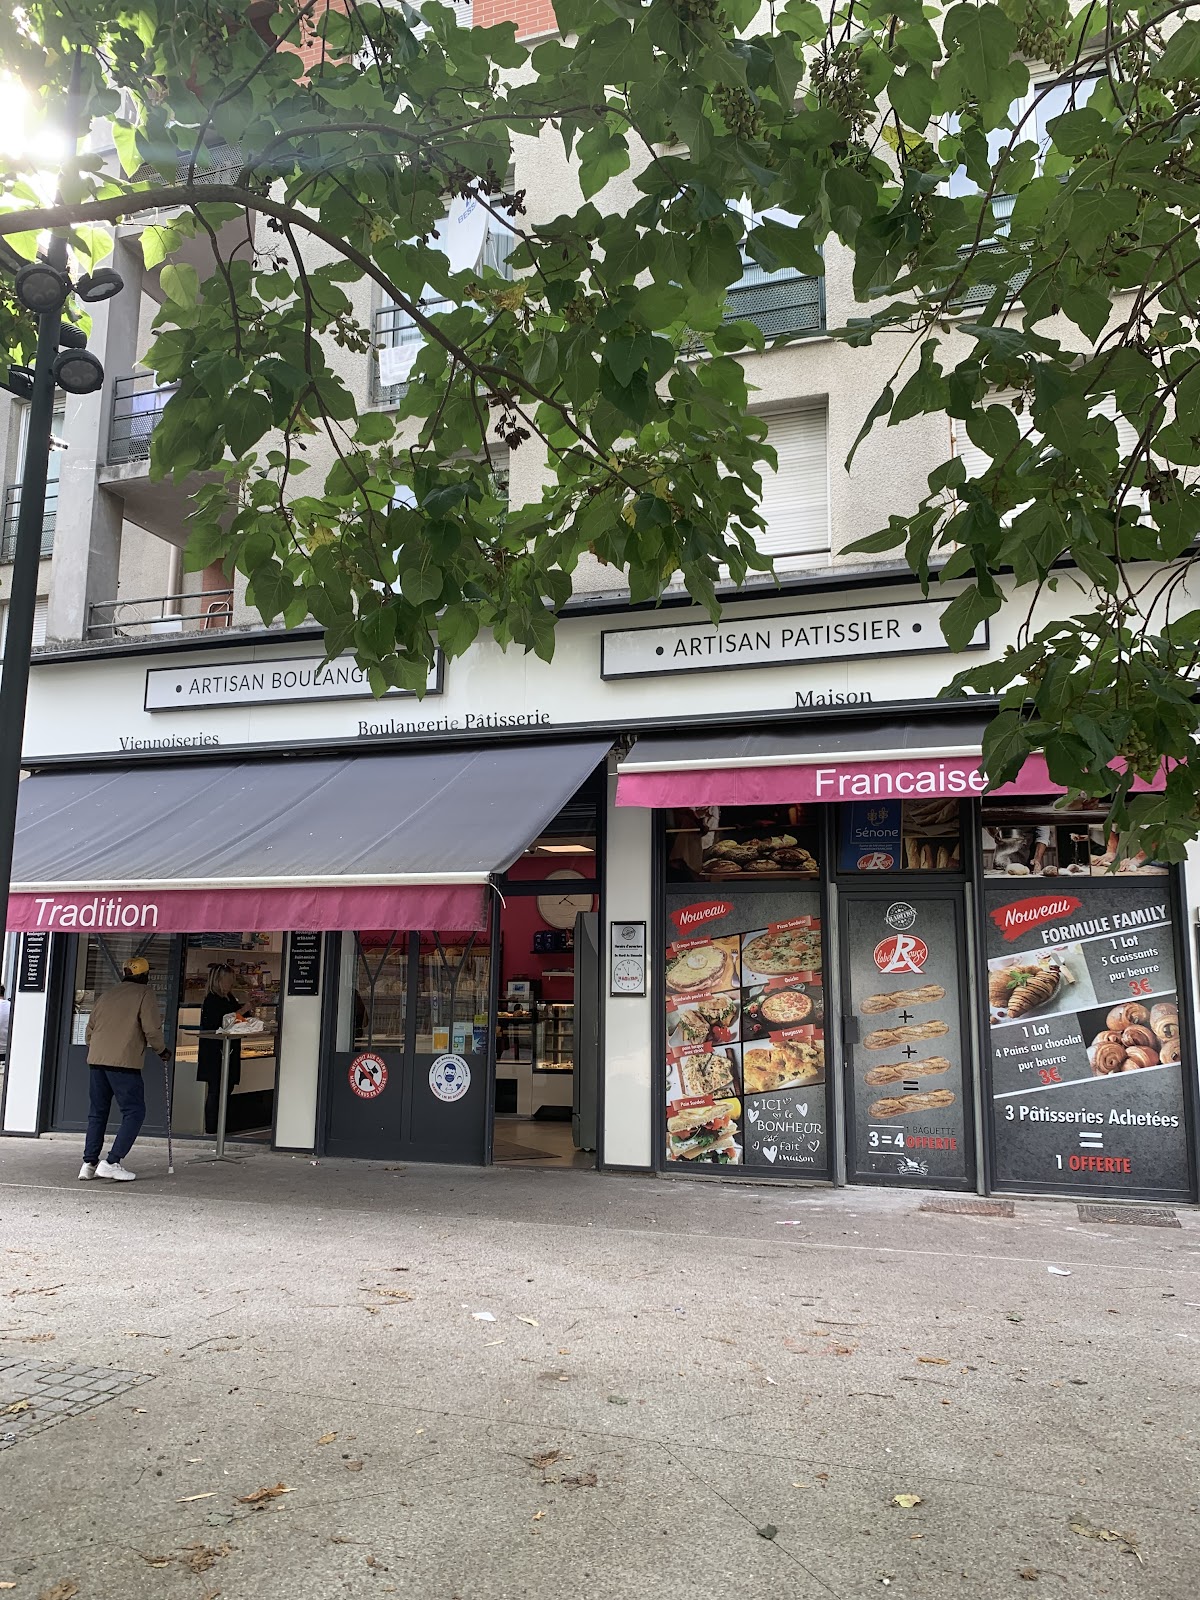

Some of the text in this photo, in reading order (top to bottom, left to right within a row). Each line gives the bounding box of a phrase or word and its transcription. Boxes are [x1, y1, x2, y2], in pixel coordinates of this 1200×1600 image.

[672, 618, 902, 658] ARTISAN PATISSIER
[188, 666, 373, 695] ARTISAN BOULANG
[795, 689, 874, 708] Maison
[357, 709, 551, 736] Boulangerie Pâtisserie
[118, 730, 220, 751] Viennoiseries
[815, 764, 988, 797] Francaise
[855, 826, 899, 838] Sénone
[33, 897, 159, 927] Tradition
[679, 902, 727, 926] Nouveau
[883, 907, 919, 925] TRADITION
[1003, 899, 1071, 928] Nouveau
[1041, 903, 1168, 945] FORMULE FAMILY
[1109, 935, 1140, 950] 1 Lot
[1101, 947, 1159, 967] 5 Croissants
[1109, 963, 1160, 984] pur beurre
[1129, 978, 1154, 997] 3€
[1021, 1023, 1051, 1038] 1 Lot
[995, 1033, 1083, 1059] 4 Pains au chocolat
[1017, 1053, 1068, 1073] pur beurre
[1037, 1067, 1064, 1085] 3€
[761, 1098, 782, 1111] ICI
[784, 1109, 794, 1119] le
[1005, 1104, 1180, 1129] 3 Pâtisseries Achetées
[757, 1120, 824, 1135] BONHEUR
[762, 1133, 780, 1142] est
[912, 1126, 957, 1136] BAGUETTE
[905, 1135, 957, 1151] OFFERTE
[778, 1152, 815, 1163] maison
[1055, 1154, 1132, 1174] 1 OFFERTE
